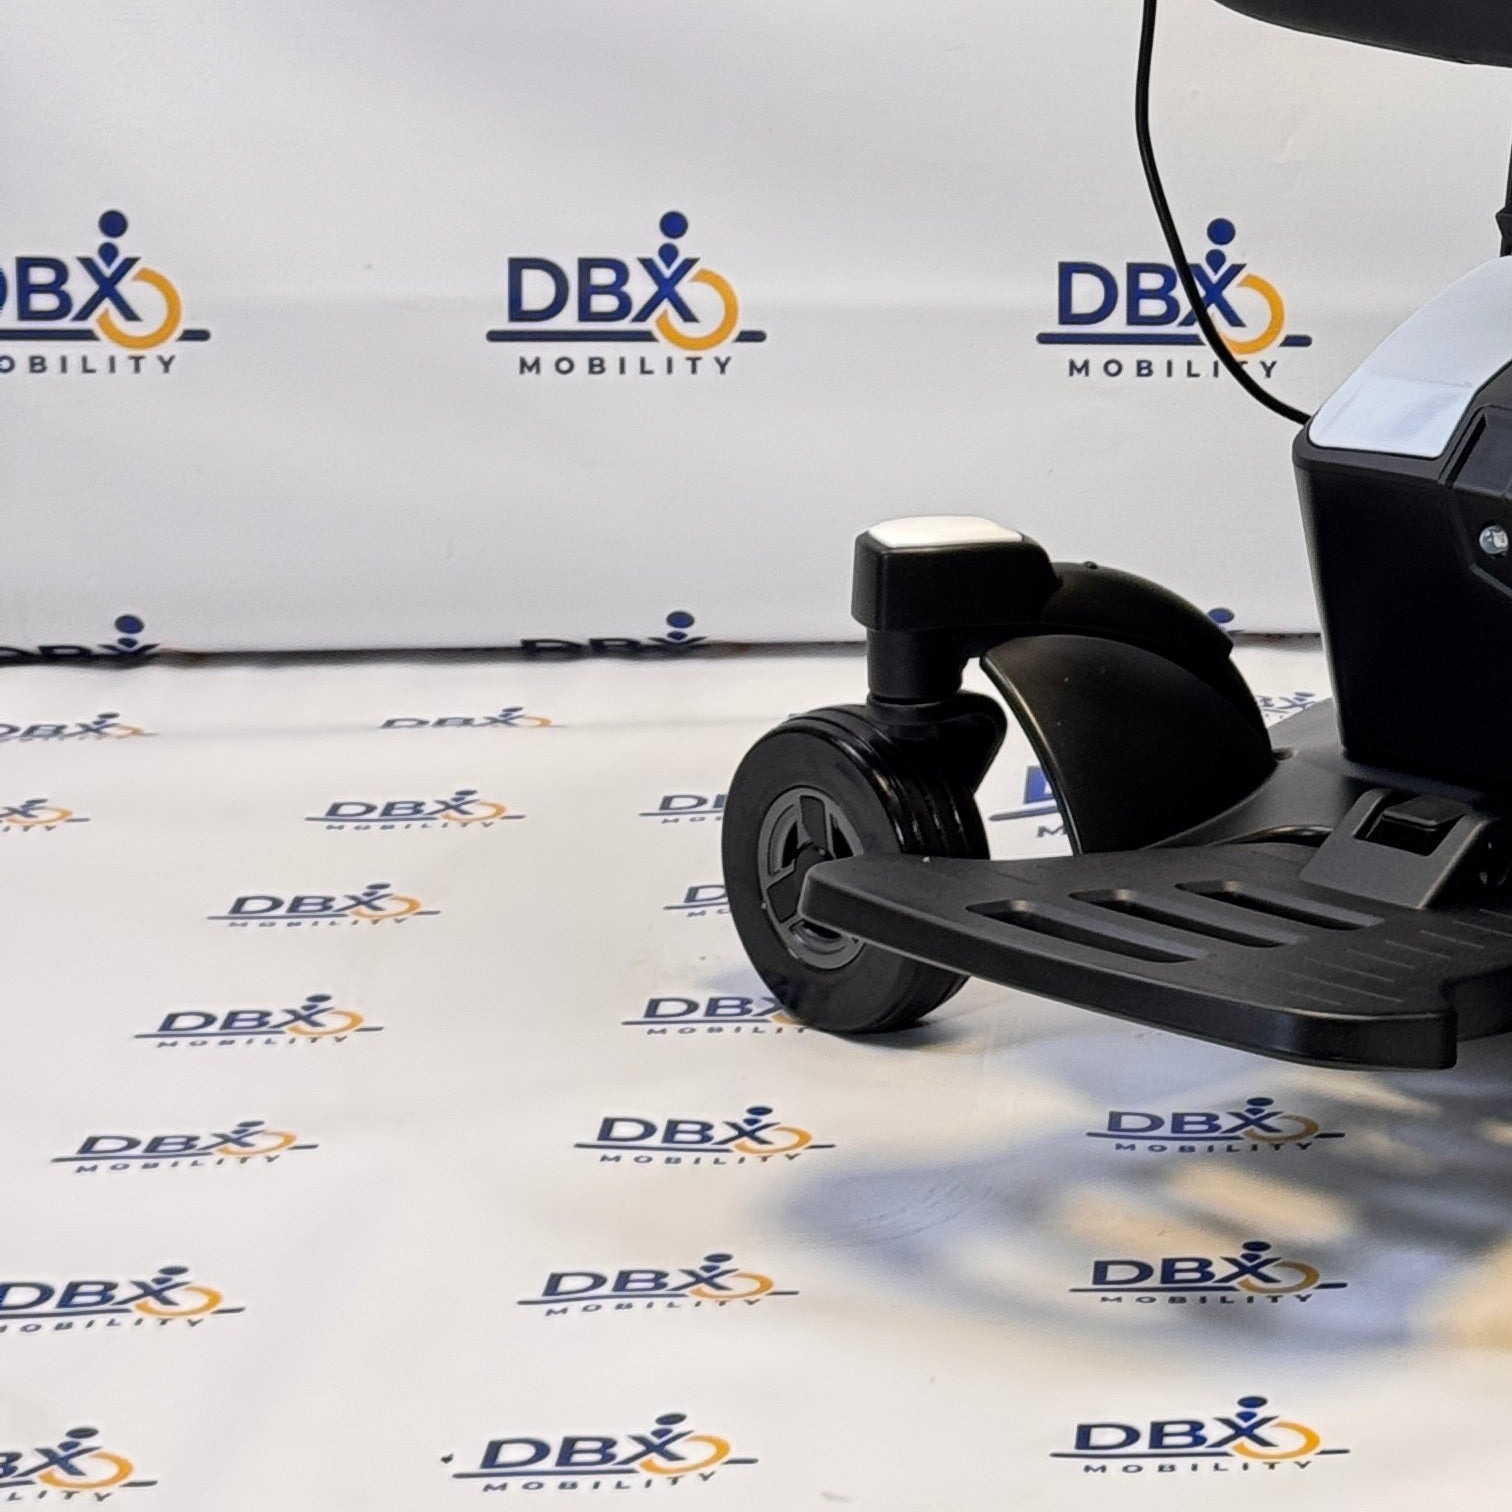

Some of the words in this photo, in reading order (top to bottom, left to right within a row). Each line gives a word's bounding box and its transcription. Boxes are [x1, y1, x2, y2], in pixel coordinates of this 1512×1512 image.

[0, 257, 142, 321] BX
[508, 257, 700, 323] DBX
[1058, 261, 1246, 328] DBX
[0, 355, 175, 374] OBILITY
[519, 357, 731, 375] MOBILITY
[1069, 359, 1276, 378] MOBILIY
[325, 800, 478, 818] DBX
[228, 893, 392, 915] DBX
[158, 1007, 333, 1032] DBX
[648, 1026, 811, 1036] MOBILIT
[597, 1117, 779, 1145] DBX
[1107, 1111, 1283, 1134] DBX
[76, 1131, 267, 1155] DBX
[1115, 1143, 1311, 1155] MOBILITY
[76, 1153, 279, 1173] MOBILITY
[600, 1152, 802, 1165] MOBILITY
[1092, 1256, 1281, 1285] DBX
[541, 1268, 733, 1297] DBX
[0, 1280, 190, 1311] DBX
[1101, 1294, 1312, 1304] MOBILITY
[546, 1299, 760, 1316] MOBILITY
[0, 1318, 203, 1333] OBILITY
[1075, 1416, 1278, 1450] DBX
[480, 1438, 694, 1471] DBX
[1084, 1461, 1311, 1473] MOBILITY
[483, 1473, 715, 1491] MOBILITY
[7, 1490, 112, 1502] LITY
